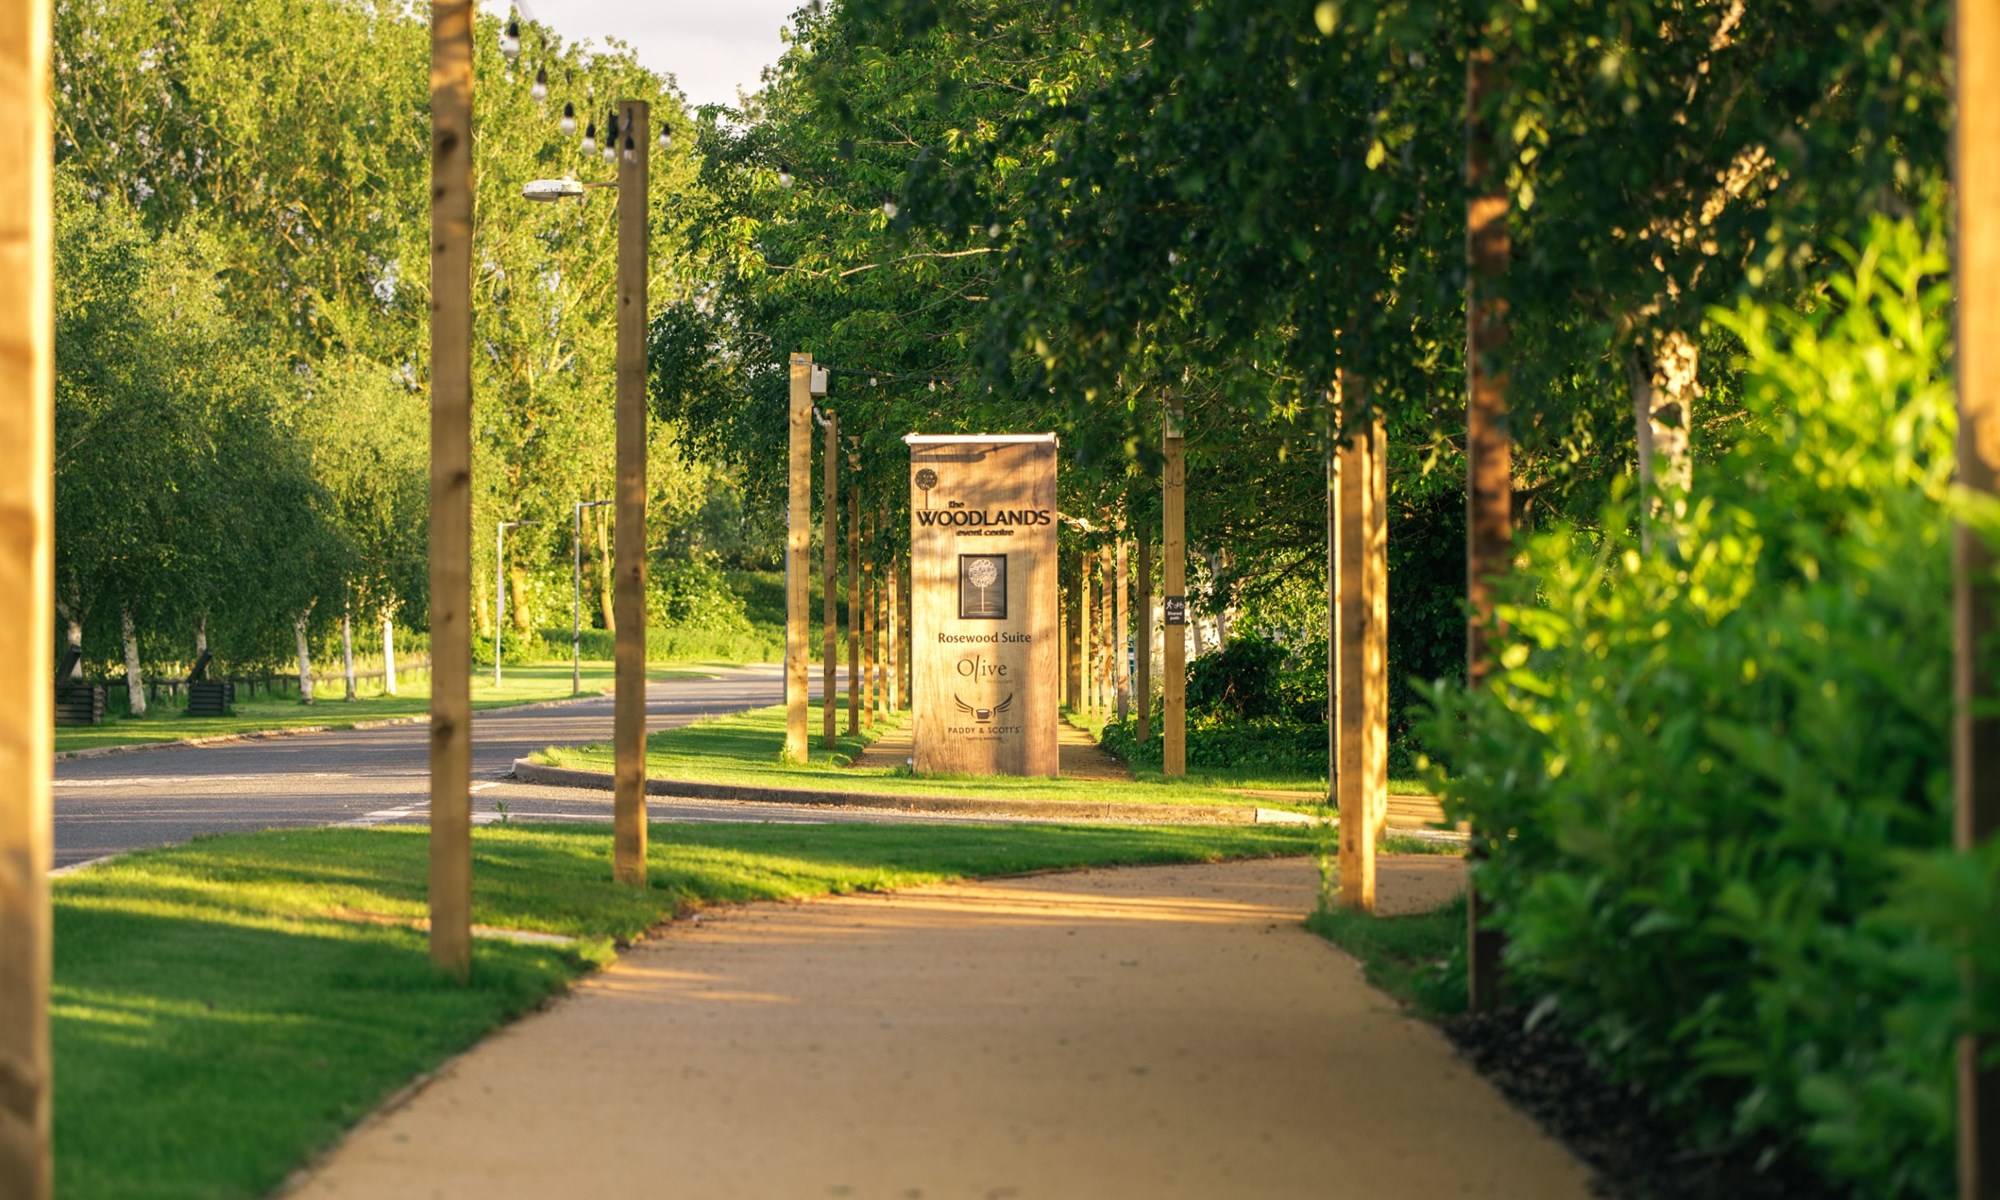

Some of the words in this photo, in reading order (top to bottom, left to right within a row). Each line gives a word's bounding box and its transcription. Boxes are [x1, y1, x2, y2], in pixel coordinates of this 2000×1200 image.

[949, 500, 965, 509] the
[916, 510, 1051, 526] WOODLANDS
[956, 529, 983, 537] event
[984, 529, 1014, 537] centre
[938, 632, 998, 643] Rosewood
[1001, 632, 1032, 643] Suite
[957, 654, 1008, 684] Olive
